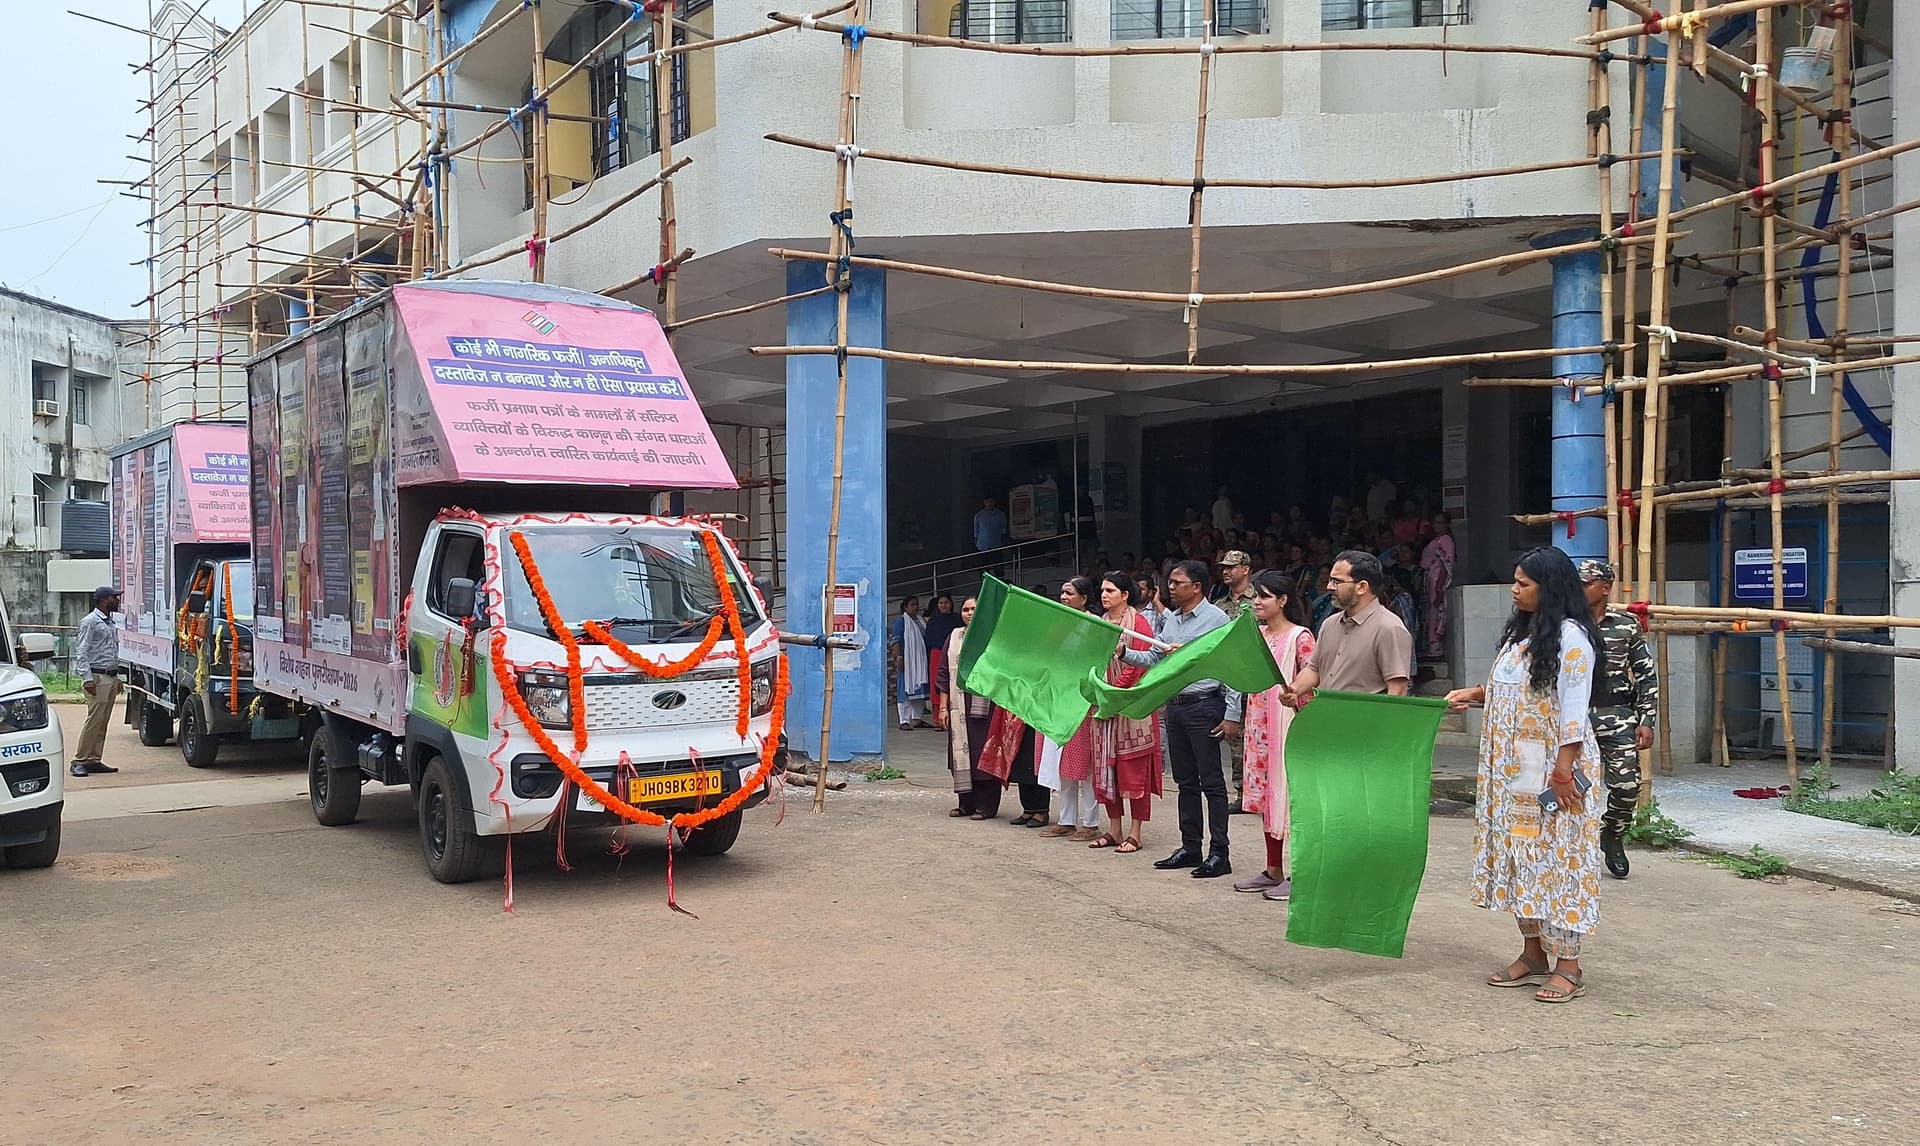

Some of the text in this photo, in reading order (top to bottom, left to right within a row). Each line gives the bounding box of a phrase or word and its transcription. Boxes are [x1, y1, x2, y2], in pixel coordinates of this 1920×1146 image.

[453, 338, 482, 356] कोई
[484, 339, 502, 357] भी
[502, 343, 550, 362] नागरिक
[434, 363, 488, 383] दस्तावेज
[490, 370, 504, 384] न
[504, 372, 546, 388] बनवाए
[548, 370, 572, 388] और
[572, 377, 584, 389] न
[584, 374, 600, 391] ही
[600, 375, 624, 393] ऐसा
[624, 381, 658, 398] प्रयास
[466, 398, 500, 412] फर्जी
[502, 402, 538, 416] प्रमाण
[540, 404, 565, 416] पत्रों
[566, 404, 580, 418] के
[582, 408, 623, 421] मामलों
[624, 408, 637, 422] में
[514, 422, 530, 436] के
[575, 428, 612, 446] कानून
[614, 428, 633, 442] की
[634, 430, 667, 443] संगत
[668, 432, 707, 445] धाराओं
[208, 454, 226, 467] कोई
[228, 455, 238, 466] भी
[474, 442, 490, 456] के
[494, 444, 546, 458] अन्तर्गत
[641, 448, 660, 464] की
[192, 470, 228, 482] दस्तावेज
[280, 650, 294, 674] विशेष
[295, 660, 310, 680] गहन
[0, 742, 43, 758] सरकार
[641, 776, 718, 796] JH09BK3210
